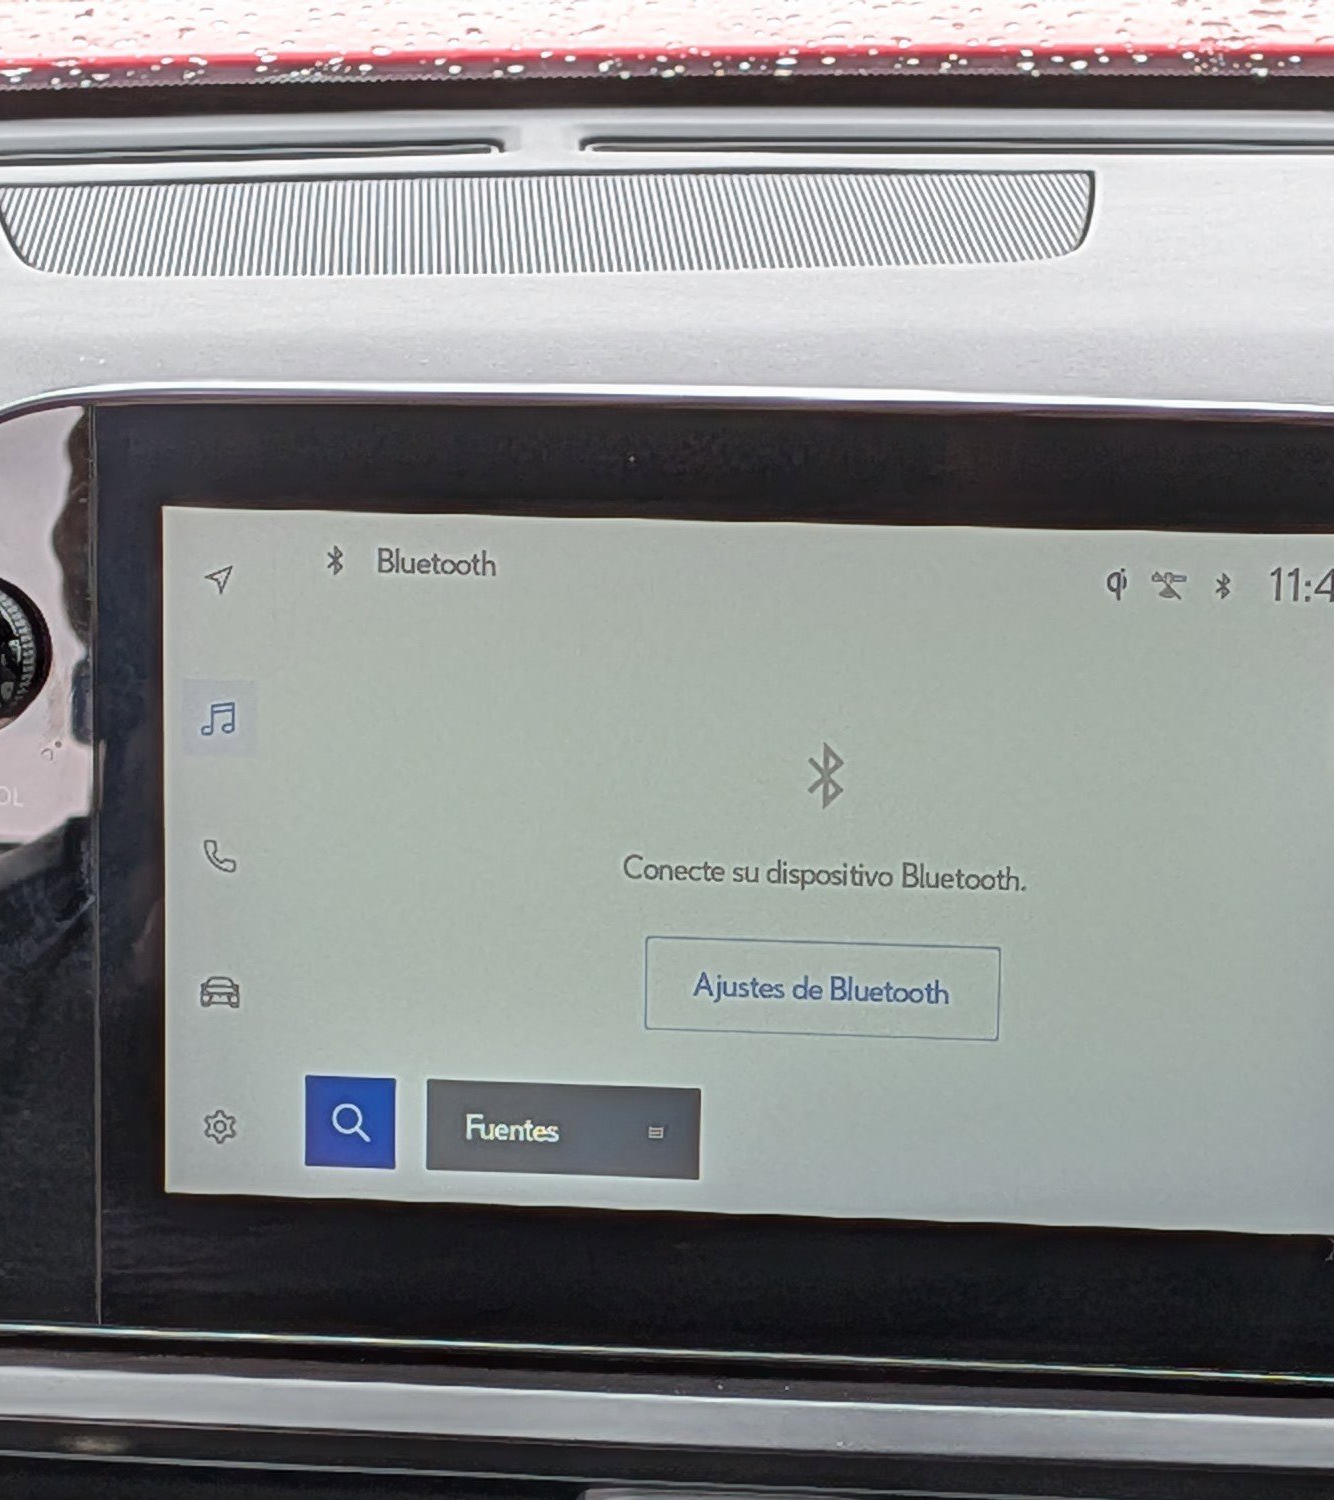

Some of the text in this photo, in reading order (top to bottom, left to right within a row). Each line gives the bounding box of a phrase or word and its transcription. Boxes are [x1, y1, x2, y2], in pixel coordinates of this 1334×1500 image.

[376, 547, 497, 577] Bluetooth
[622, 853, 1028, 893] Conecte su dispositivo Bluetooth.
[693, 970, 950, 1006] Ajustes de Bluetooth
[465, 1113, 560, 1144] Fuentes
